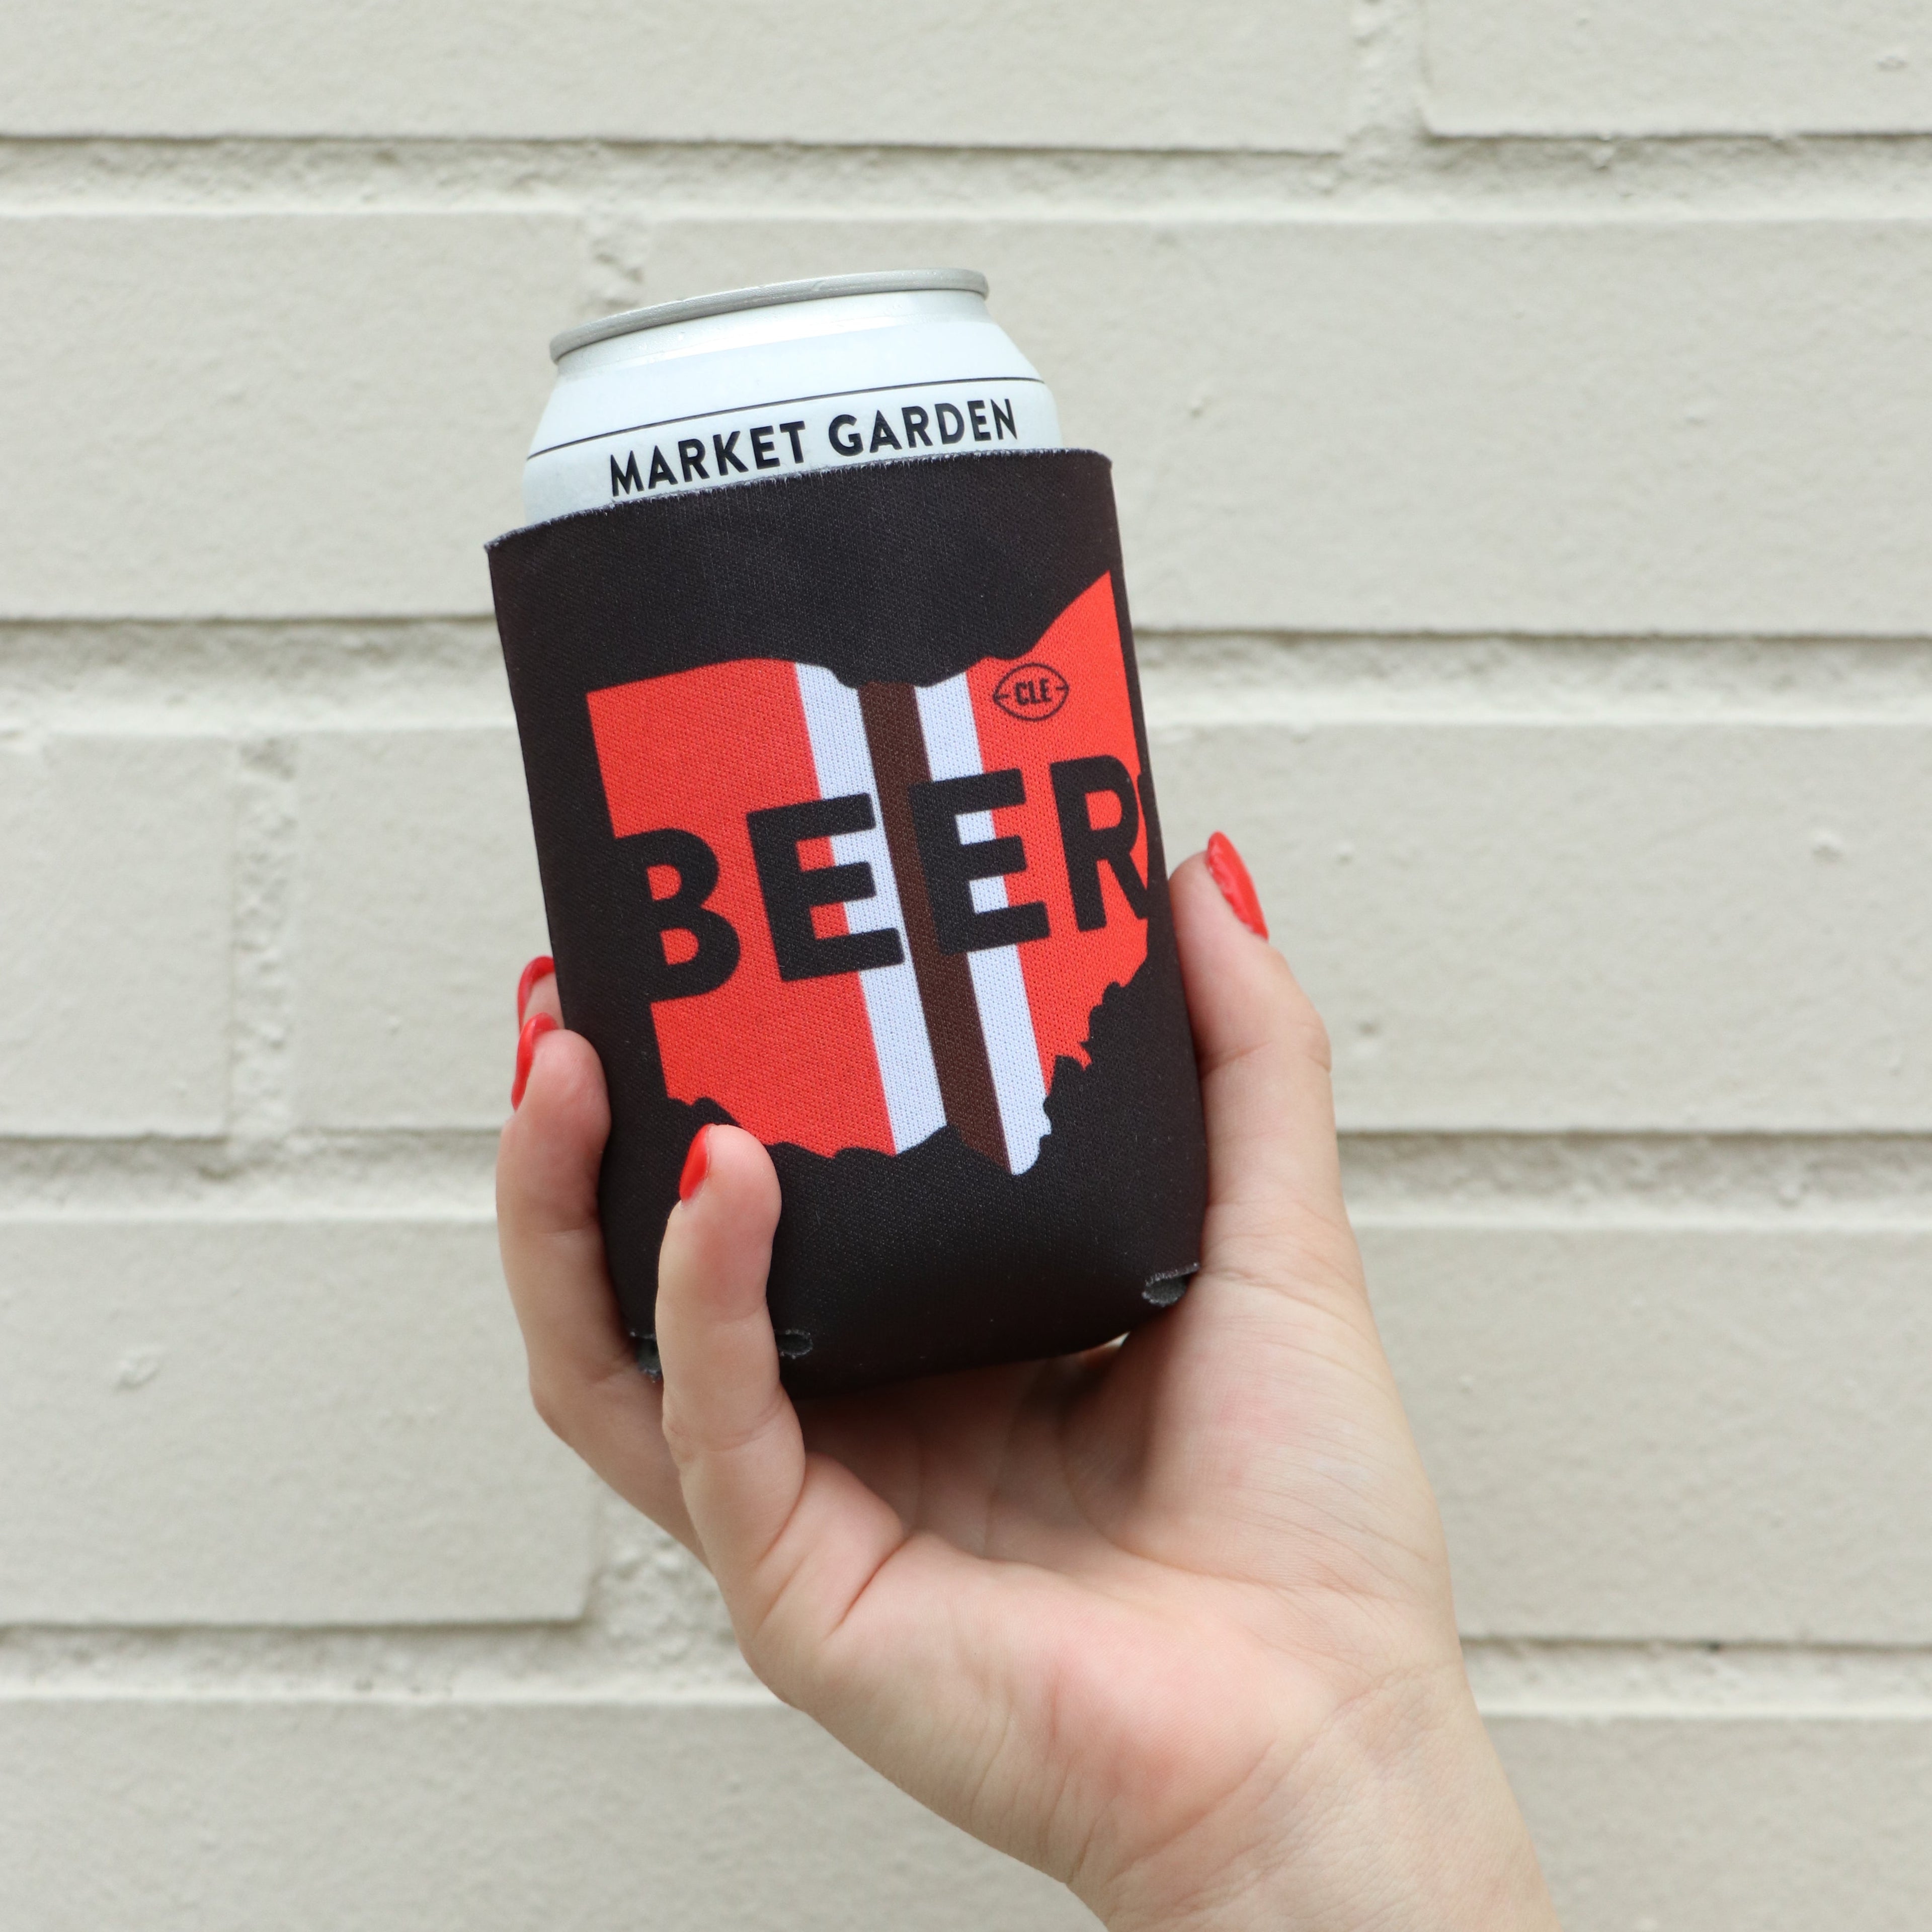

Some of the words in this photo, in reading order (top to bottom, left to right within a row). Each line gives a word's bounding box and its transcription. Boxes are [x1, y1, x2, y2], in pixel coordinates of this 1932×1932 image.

[609, 421, 806, 498] MARKET
[828, 398, 1018, 456] GARDEN
[1014, 677, 1052, 706] CLE
[615, 755, 1149, 1003] BEER
